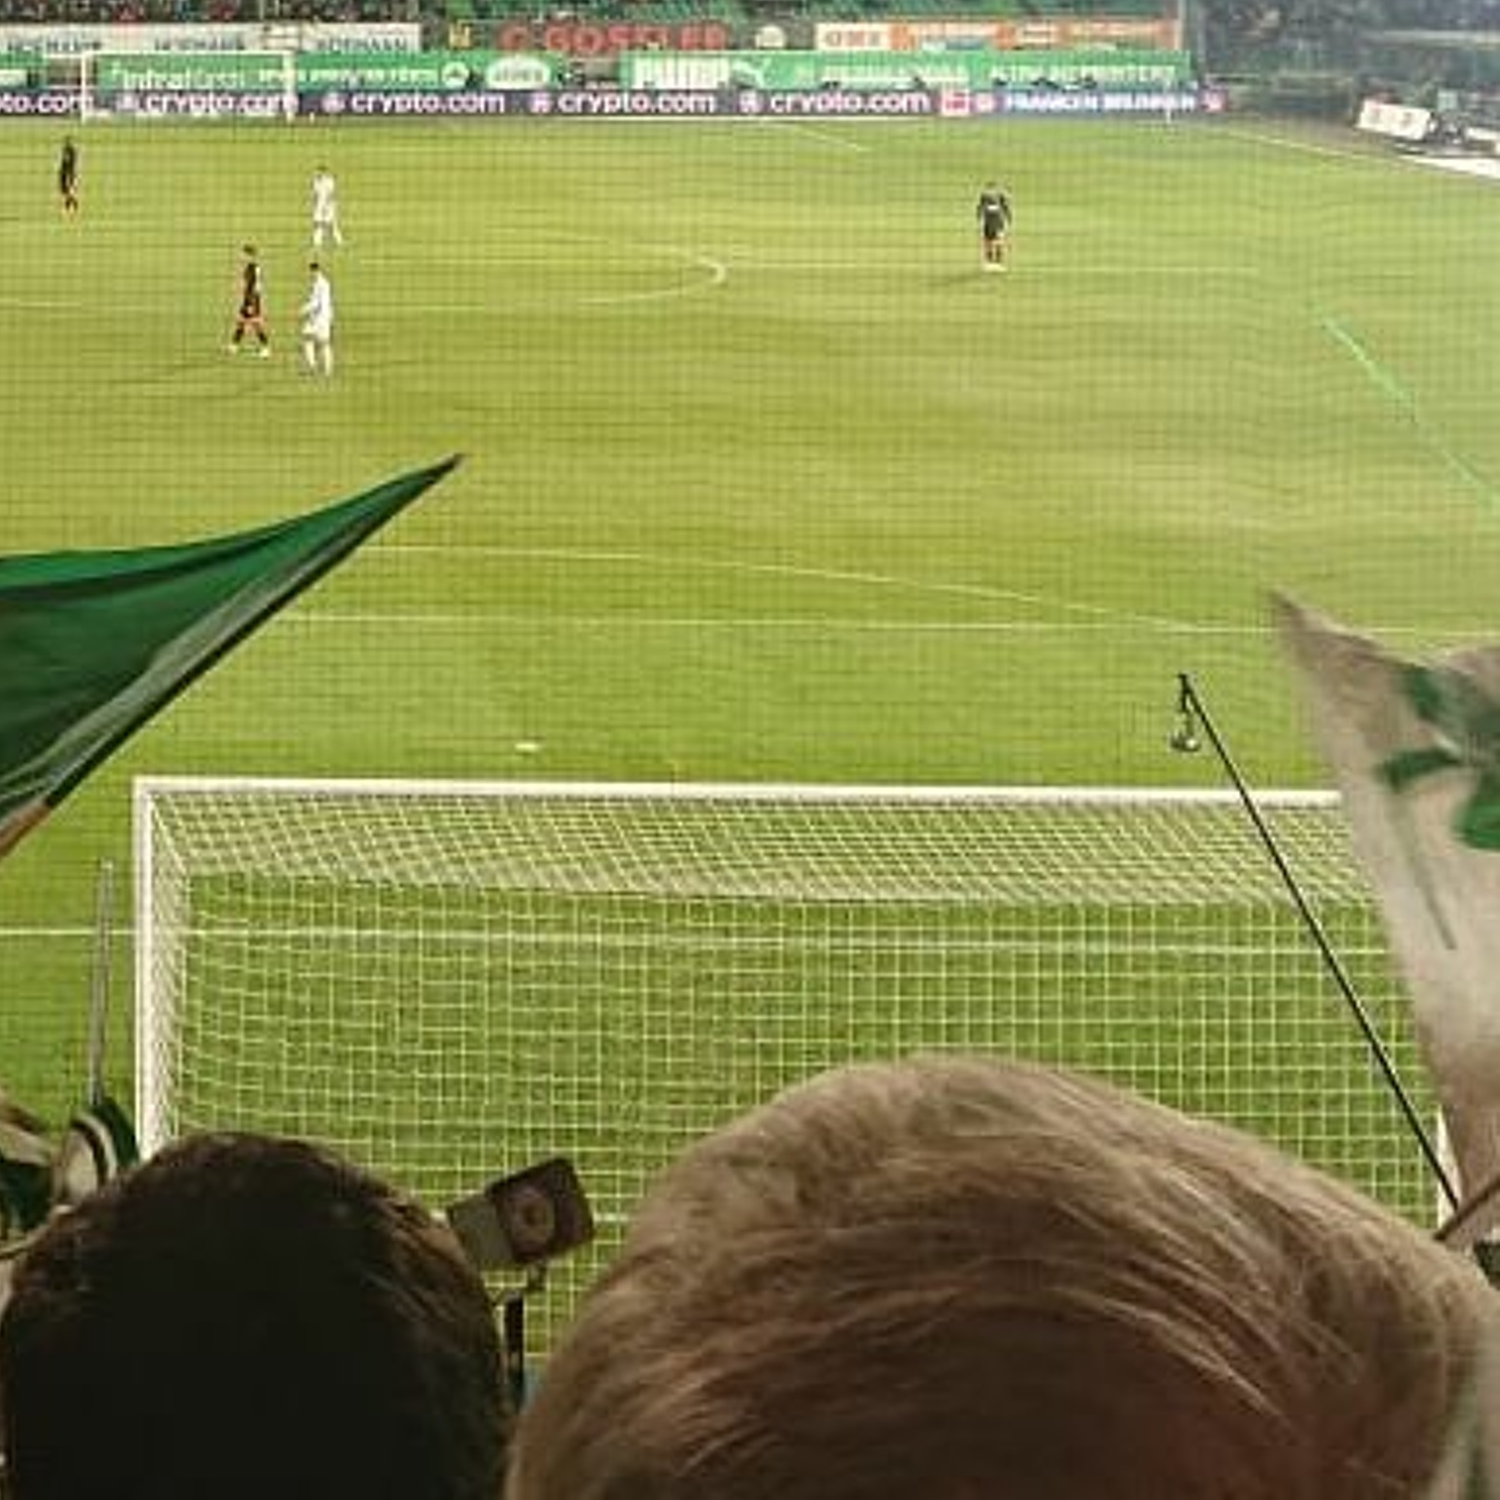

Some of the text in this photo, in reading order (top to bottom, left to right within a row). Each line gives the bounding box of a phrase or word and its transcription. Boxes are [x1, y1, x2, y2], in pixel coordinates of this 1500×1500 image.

[351, 92, 504, 114] crypto.com
[558, 92, 716, 114] crypto.com
[770, 90, 931, 113] crypto.com
